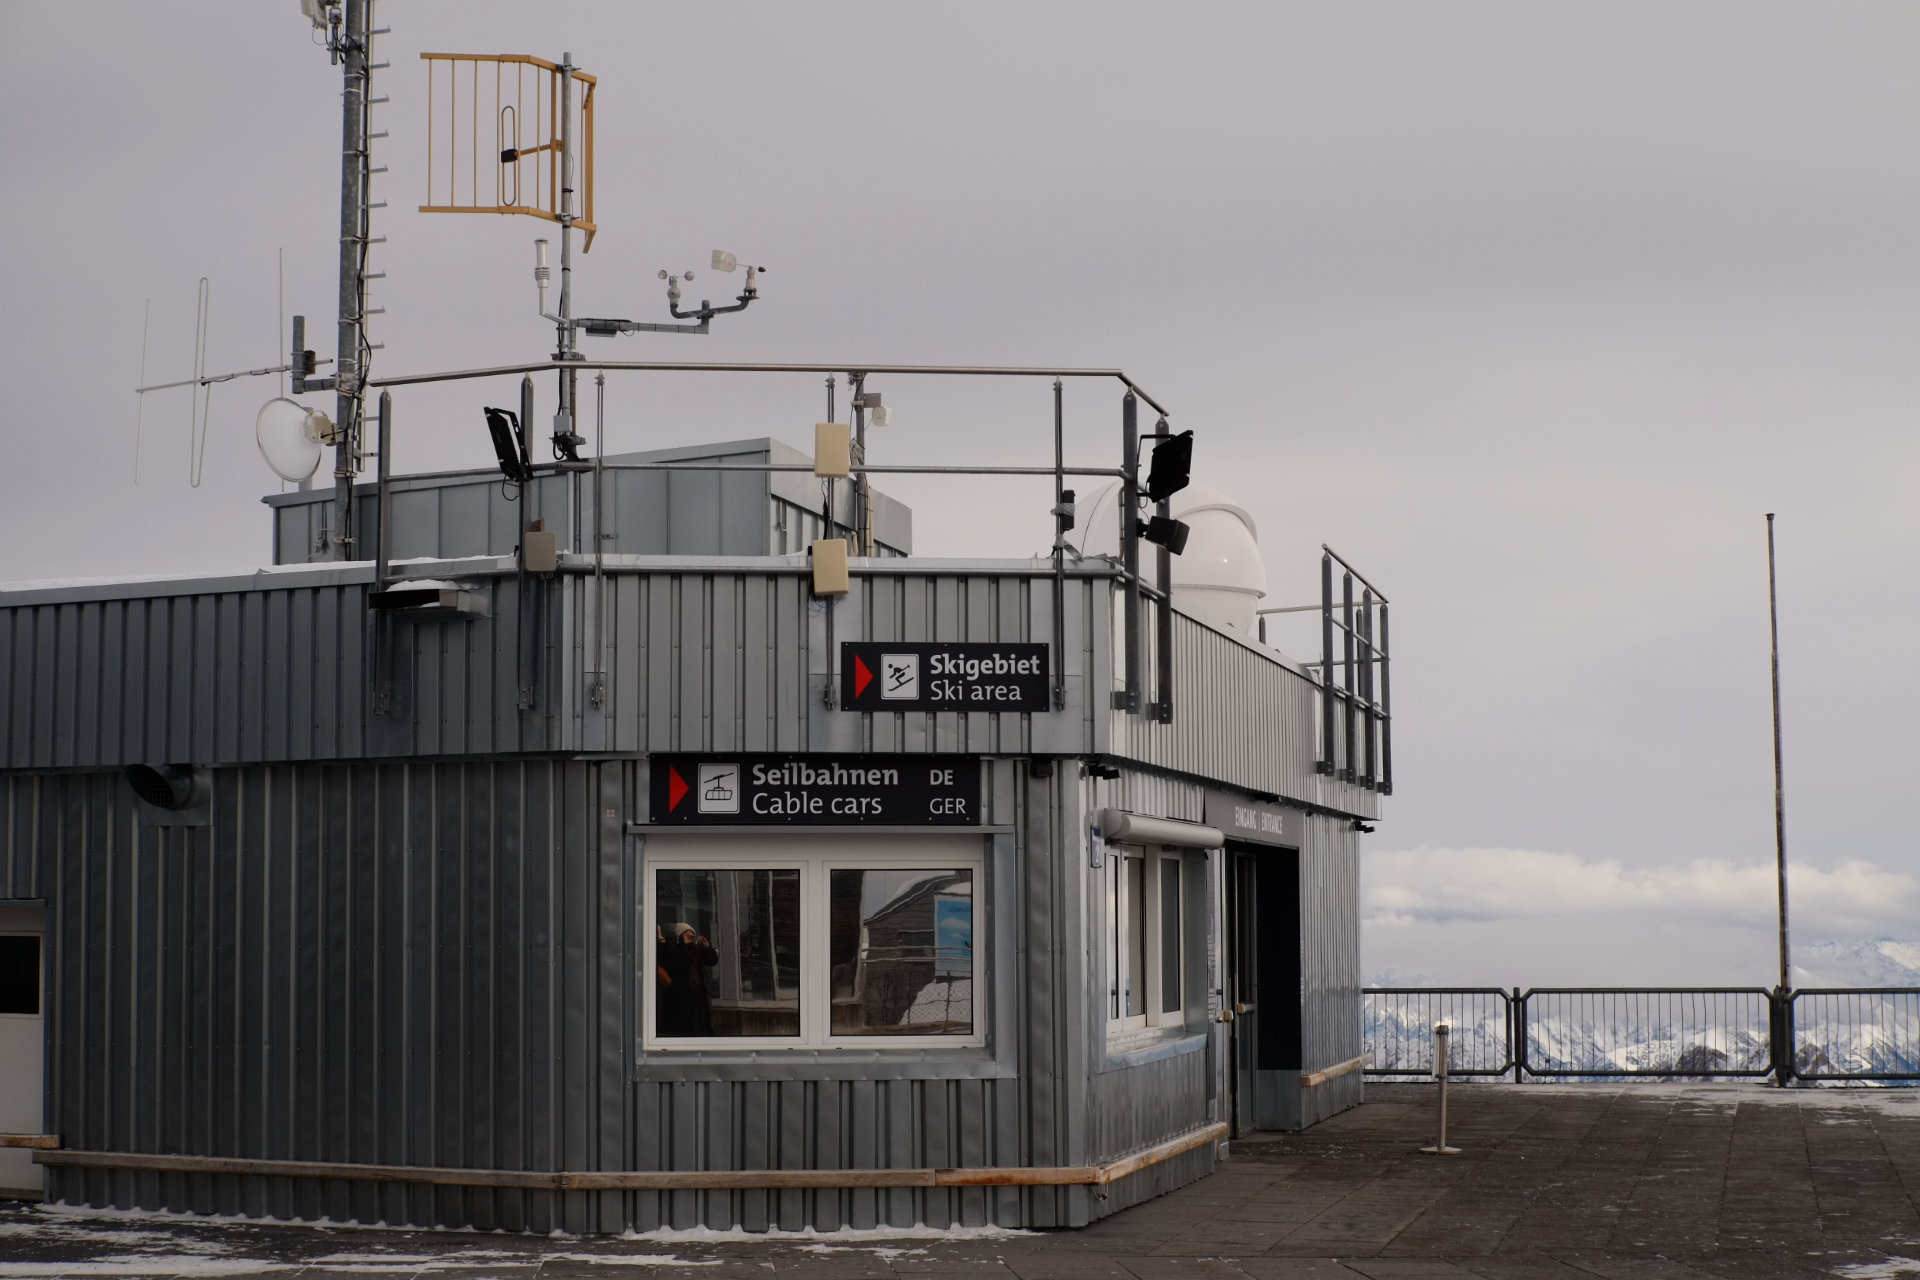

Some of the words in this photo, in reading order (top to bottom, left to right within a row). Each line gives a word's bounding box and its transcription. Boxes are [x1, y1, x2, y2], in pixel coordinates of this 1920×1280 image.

[931, 653, 1040, 681] Skigebiet
[930, 680, 963, 701] Ski
[970, 685, 1023, 701] area
[752, 763, 899, 786] Seilbahnen
[930, 769, 954, 786] DE
[752, 791, 823, 815] Cable
[831, 797, 883, 815] cars
[929, 797, 966, 815] GER
[1235, 805, 1257, 830] EINGANG
[1261, 811, 1283, 835] ENTRANCE
